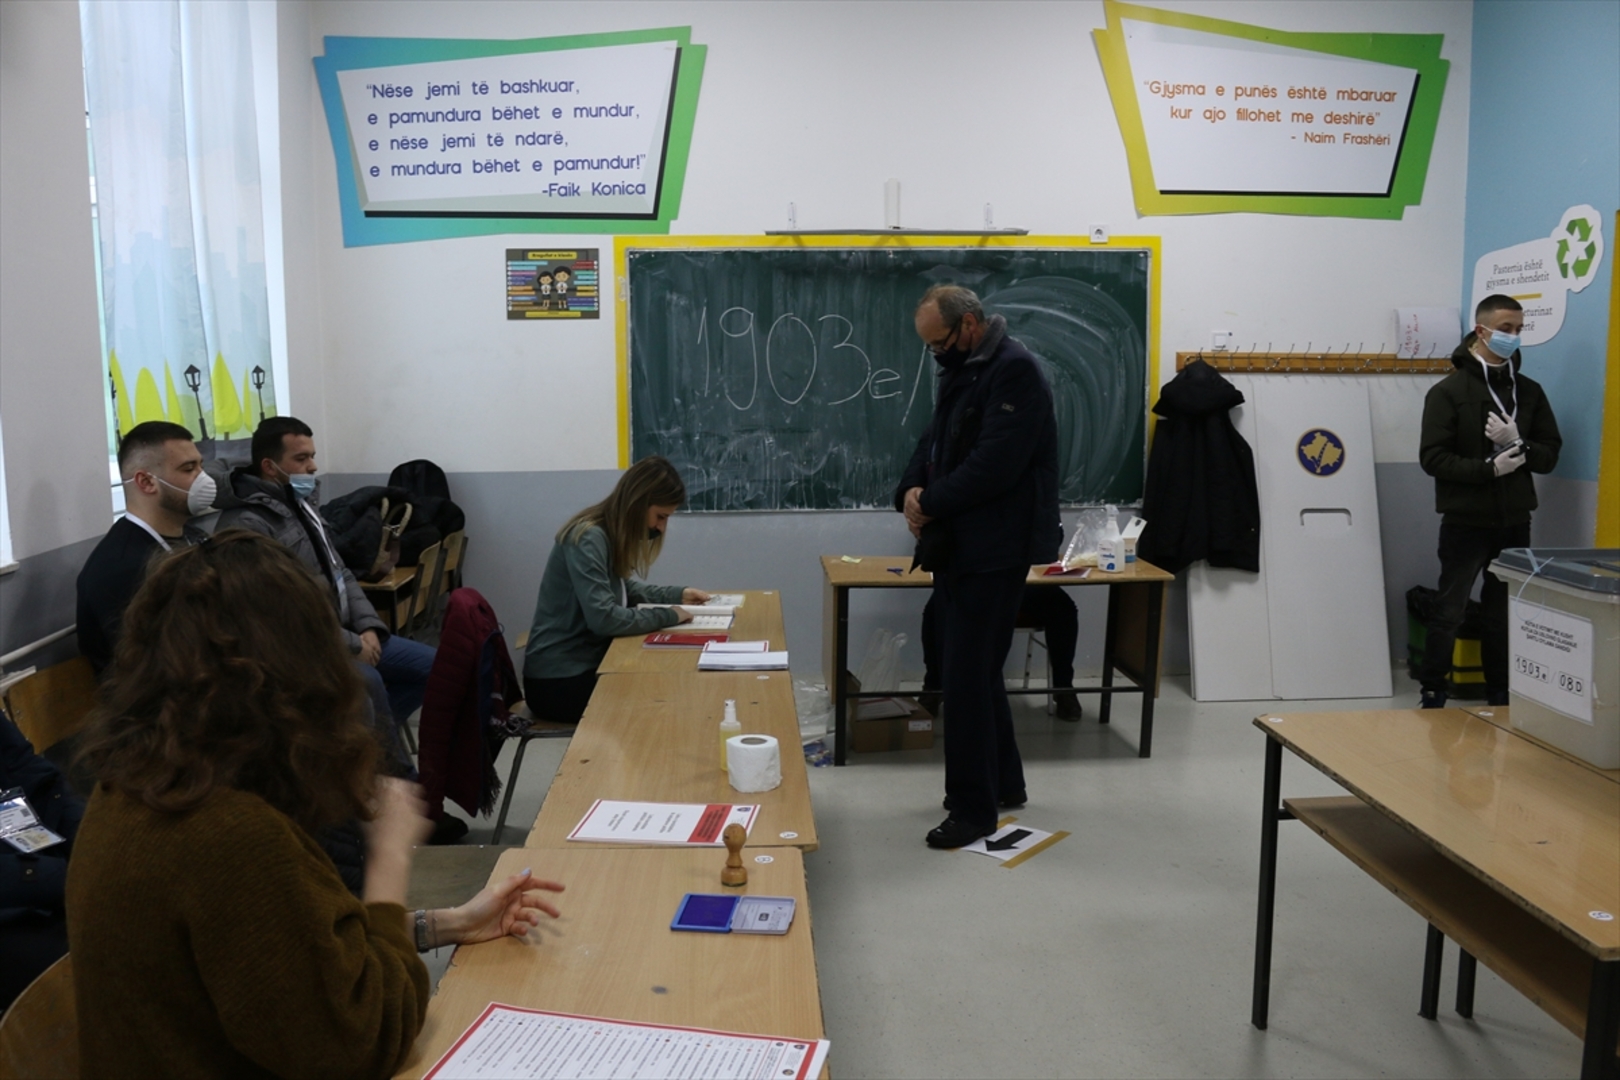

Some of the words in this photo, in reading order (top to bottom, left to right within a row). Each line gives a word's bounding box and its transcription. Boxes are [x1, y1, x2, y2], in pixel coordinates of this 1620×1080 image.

[425, 81, 460, 100] jemi
[472, 81, 489, 95] të
[500, 79, 579, 94] bashkuar,
[1216, 86, 1225, 96] e
[1235, 85, 1277, 100] punës
[1288, 86, 1327, 100] është
[1337, 88, 1397, 102] mbaruar
[368, 113, 378, 125] e
[389, 108, 481, 128] pamundura
[492, 106, 540, 120] bëhet
[552, 108, 562, 119] e
[574, 103, 639, 118] mundur,
[1171, 106, 1193, 119] kur
[1203, 107, 1226, 123] ajo
[1236, 108, 1281, 122] fillohet
[1292, 112, 1314, 123] me
[369, 140, 379, 151] e
[390, 136, 428, 150] nëse
[441, 133, 475, 152] jemi
[487, 133, 504, 147] të
[515, 131, 567, 146] ndarë,
[1304, 132, 1335, 143] Naim
[1343, 133, 1390, 145] Frashëri
[370, 166, 380, 177] e
[391, 161, 461, 176] mundura
[473, 159, 520, 173] bëhet
[532, 160, 542, 172] e
[542, 183, 580, 197] -Faik
[592, 181, 646, 196] Konica
[1524, 259, 1543, 270] është
[1486, 277, 1509, 290] gjysma
